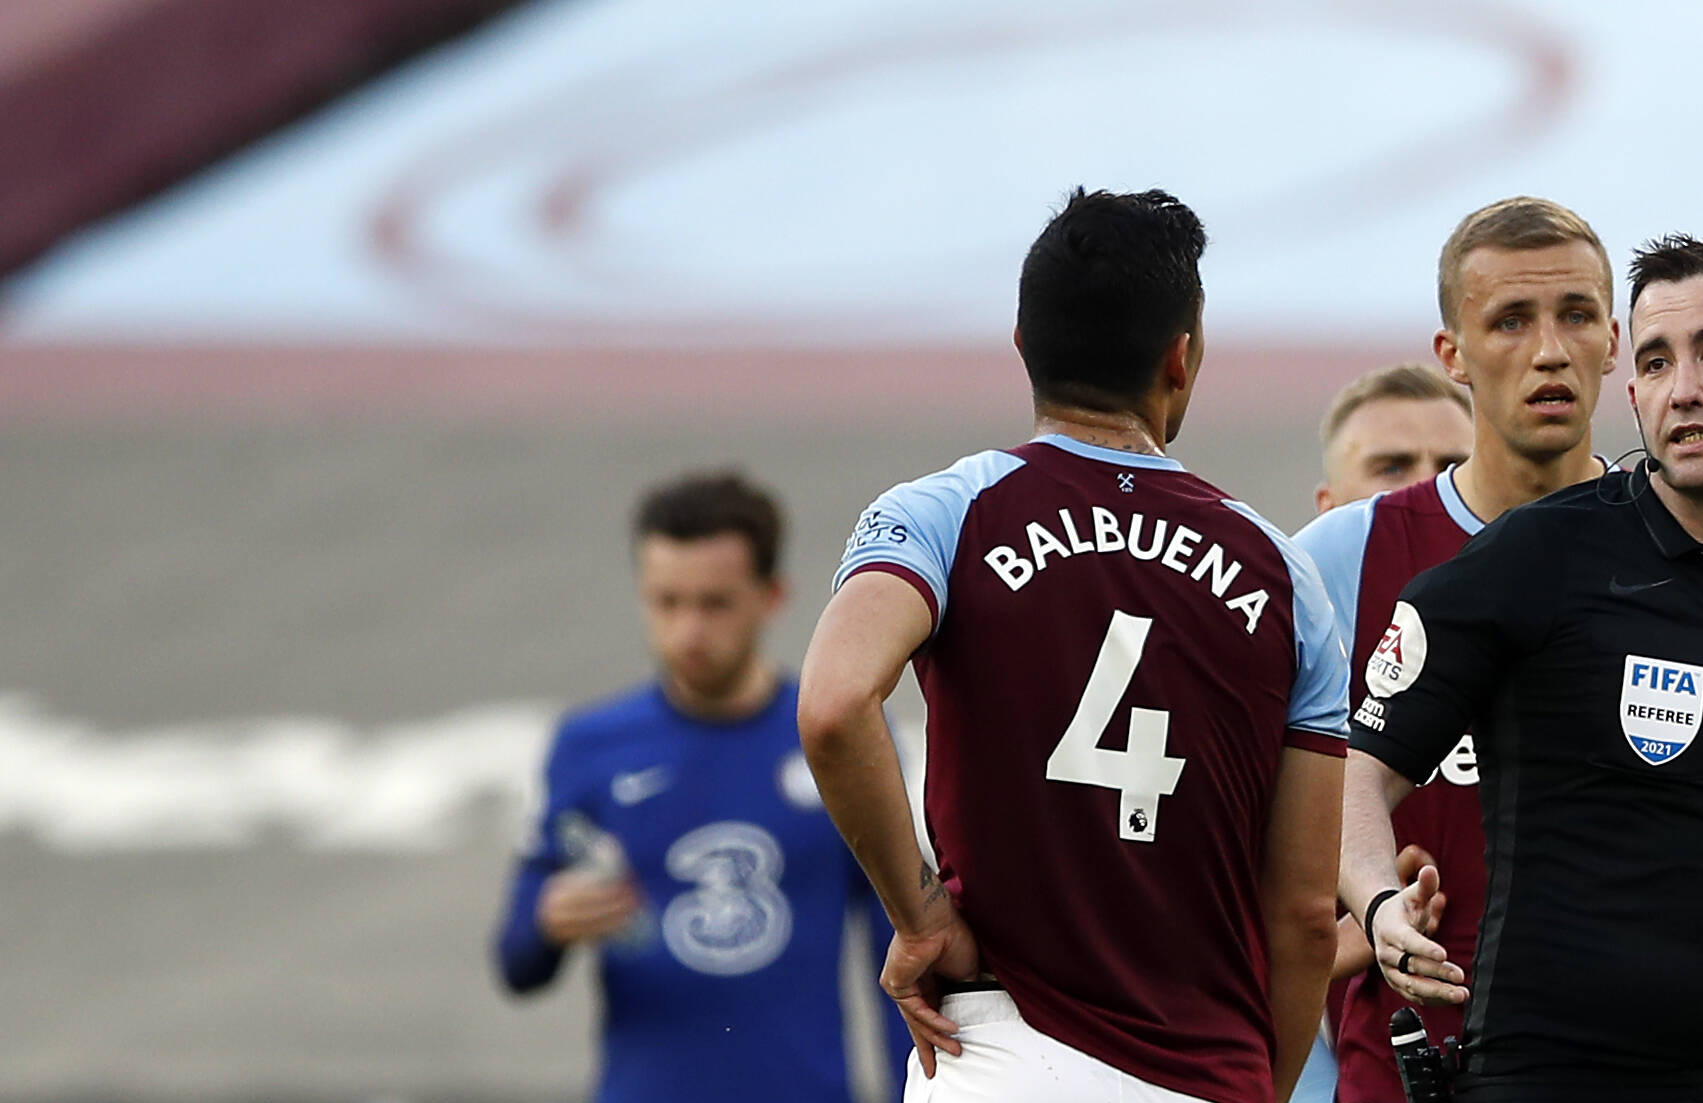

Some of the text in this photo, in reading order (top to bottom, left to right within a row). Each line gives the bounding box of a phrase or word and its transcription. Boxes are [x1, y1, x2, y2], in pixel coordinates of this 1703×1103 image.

[983, 506, 1270, 635] BALBUENA
[1631, 663, 1697, 696] FIFA
[1045, 609, 1186, 843] 4
[1627, 703, 1695, 726] REFEREE
[1640, 740, 1673, 756] 2021
